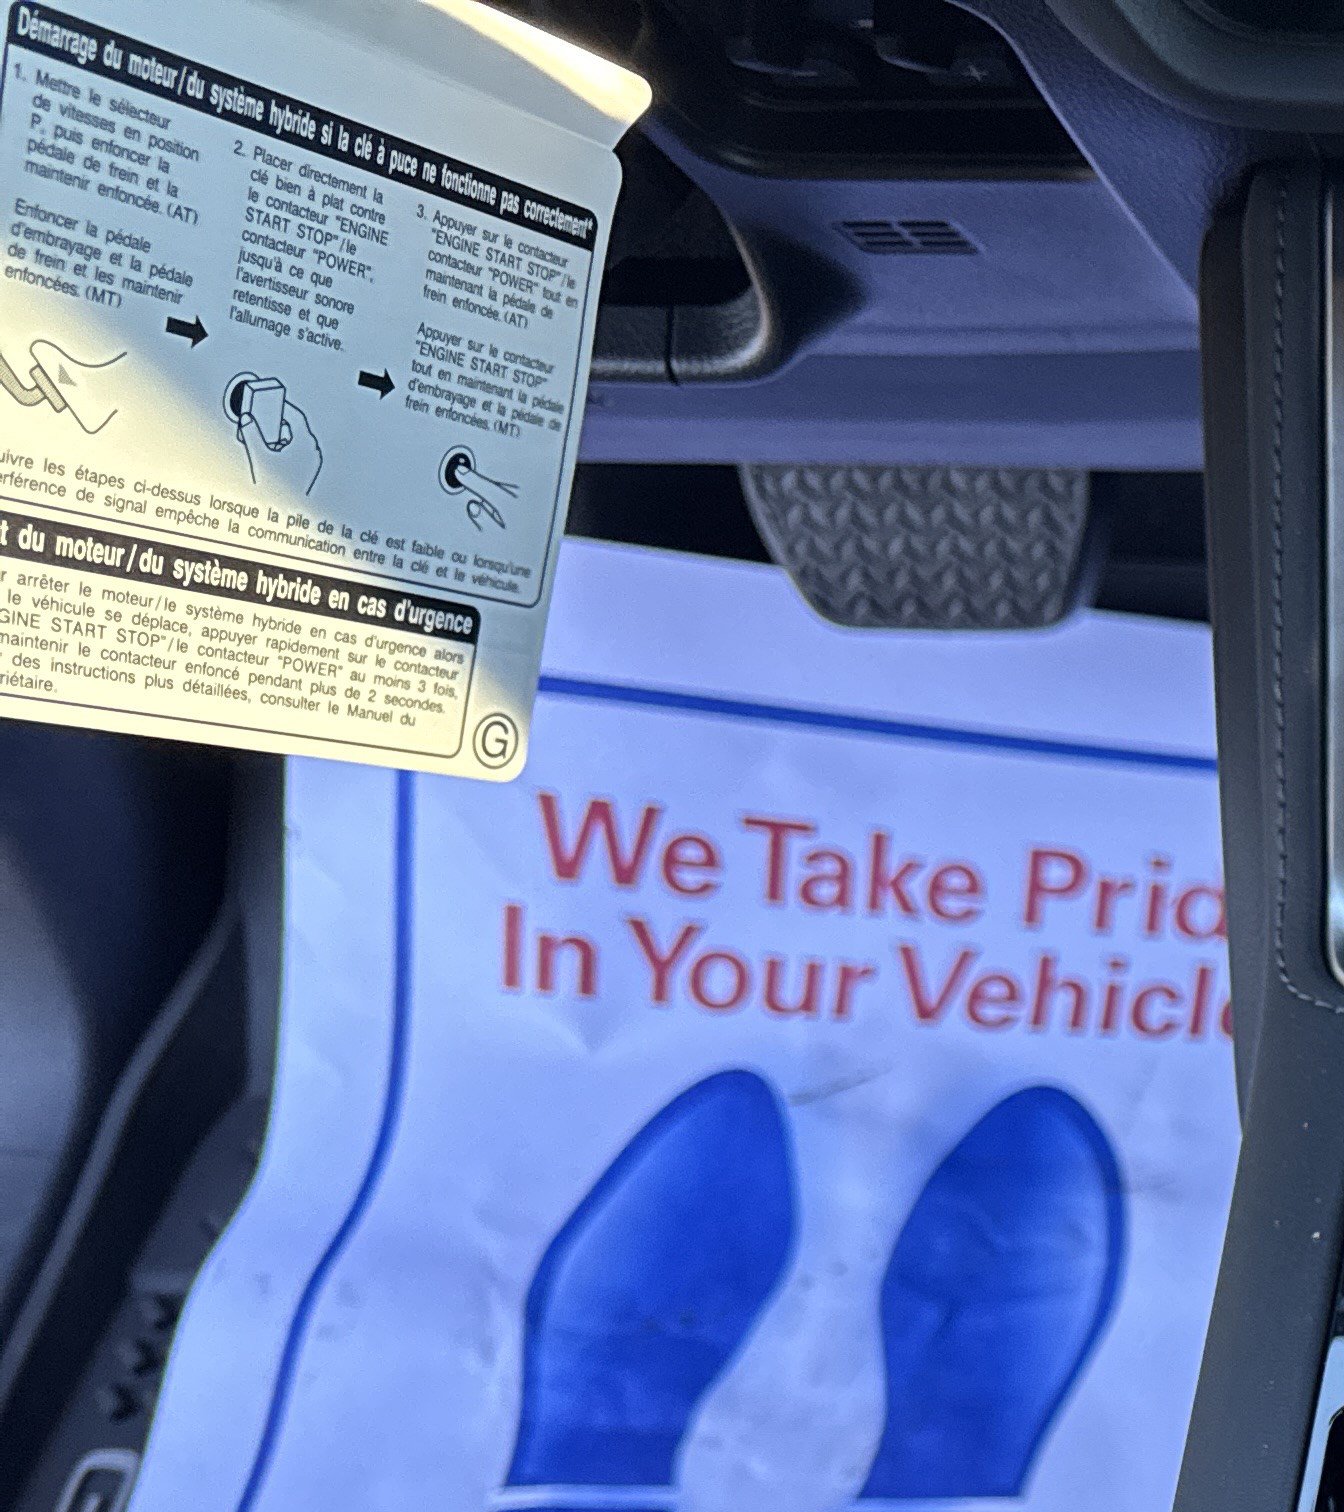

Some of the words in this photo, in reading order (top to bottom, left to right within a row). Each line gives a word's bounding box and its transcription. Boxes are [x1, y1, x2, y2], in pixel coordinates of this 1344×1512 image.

[16, 4, 97, 65] Démarrage
[102, 39, 123, 70] du
[208, 83, 264, 121] système
[268, 98, 316, 140] hybride
[319, 120, 334, 146] si
[336, 124, 349, 152] la
[353, 132, 373, 161] clé
[375, 137, 385, 165] à
[387, 149, 418, 177] puce
[421, 161, 437, 184] ne
[440, 162, 497, 206] fonctionne
[498, 190, 520, 215] pas
[42, 457, 65, 476] les
[74, 464, 125, 489] étapes
[133, 479, 201, 506] ci-dessus
[209, 494, 259, 518] lorsque
[266, 507, 279, 523] la
[285, 513, 310, 530] pile
[316, 519, 334, 535] de
[75, 486, 95, 503] de
[103, 494, 147, 514] signal
[154, 505, 220, 529] empêche
[227, 517, 240, 534] la
[247, 525, 346, 556] communication
[352, 547, 386, 565] entre
[16, 572, 70, 593] arrêter
[78, 580, 92, 597] le
[185, 603, 244, 624] système
[251, 612, 302, 635] hybride
[309, 626, 327, 639] en
[333, 630, 357, 645] cas
[363, 634, 427, 658] d'urgence
[433, 647, 464, 665] alors
[17, 522, 45, 553] du
[171, 557, 249, 592] système
[255, 568, 321, 605] hybride
[327, 588, 350, 611] en
[356, 594, 387, 618] cas
[393, 597, 473, 635] d'urgence
[7, 589, 21, 605] le
[31, 595, 95, 618] véhicule
[104, 609, 122, 623] se
[200, 625, 258, 647] appuyer
[265, 636, 340, 660] rapidement
[347, 651, 368, 664] sur
[374, 653, 386, 668] le
[393, 659, 459, 680] contacteur
[50, 616, 106, 639] START
[196, 644, 269, 666] contacteur
[277, 654, 343, 678] "POWER"
[348, 669, 366, 683] au
[372, 674, 411, 690] moins
[416, 678, 426, 693] 3
[77, 641, 91, 657] le
[99, 647, 177, 670] contacteur
[184, 661, 240, 680] enfoncé
[247, 672, 302, 691] pendant
[309, 680, 337, 696] plus
[343, 685, 361, 700] de
[367, 688, 377, 703] 2
[383, 693, 445, 714] secondes.
[11, 652, 40, 670] des
[50, 660, 136, 684] instructions
[144, 672, 174, 690] plus
[182, 678, 251, 703] détaillées,
[259, 692, 320, 711] consulter
[327, 699, 339, 715] le
[346, 703, 393, 723] Manuel
[399, 712, 416, 726] du
[539, 794, 719, 895] We
[744, 817, 981, 920] Take
[504, 904, 596, 996] In
[629, 918, 871, 1017] Your
